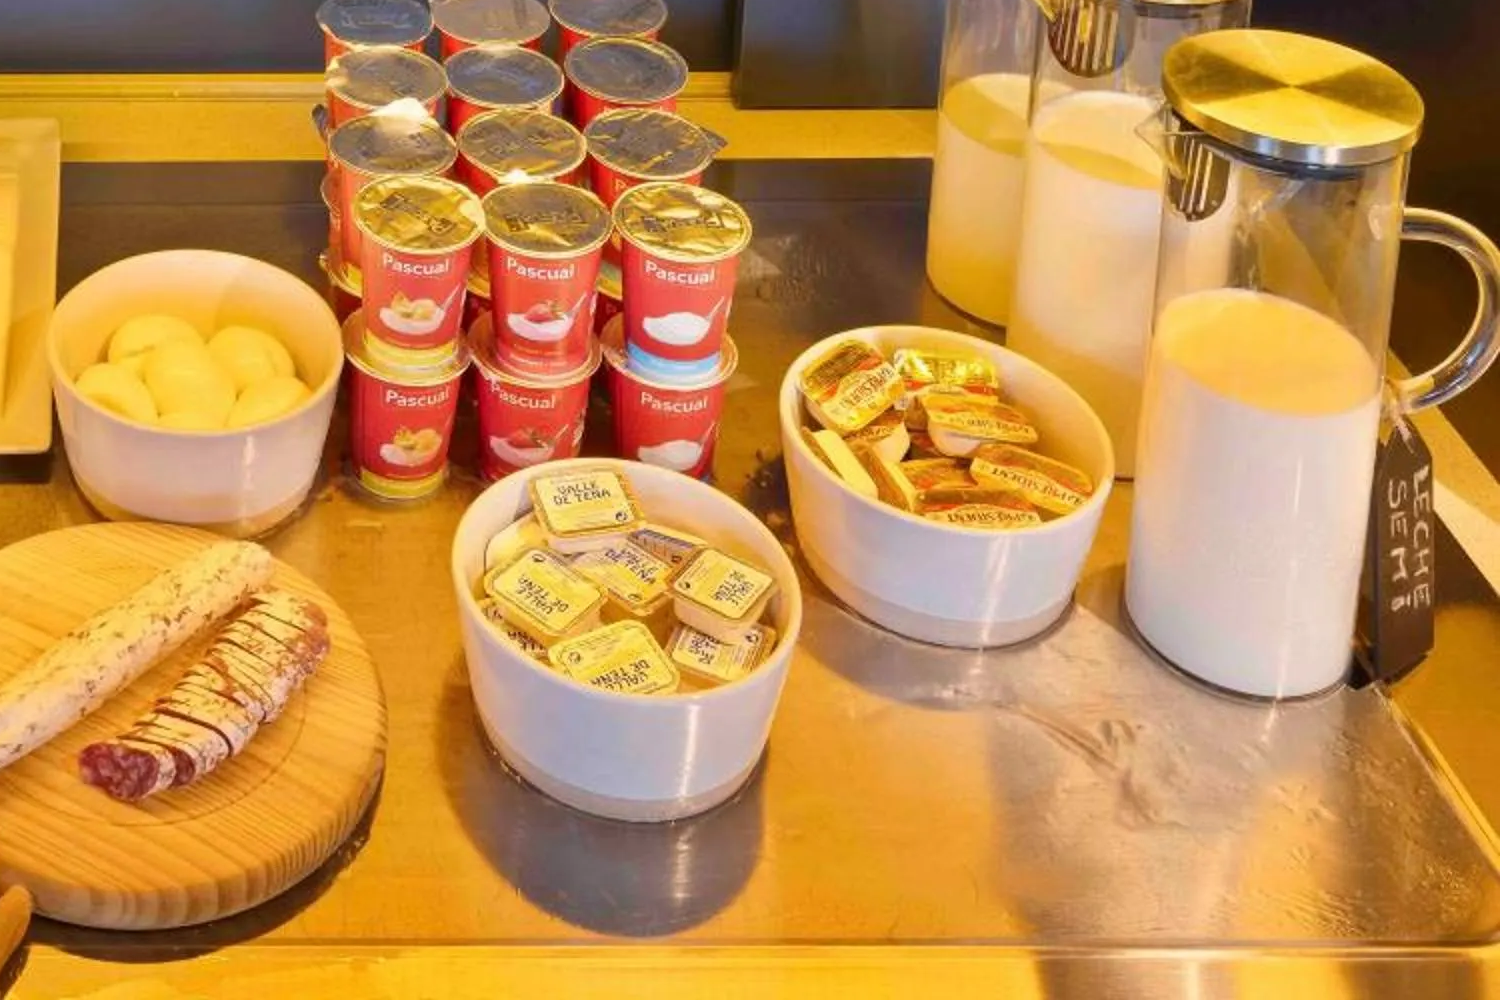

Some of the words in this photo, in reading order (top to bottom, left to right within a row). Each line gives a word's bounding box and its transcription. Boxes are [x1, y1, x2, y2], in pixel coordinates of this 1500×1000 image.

[382, 252, 450, 277] Pascual
[506, 256, 576, 281] Pascual
[644, 259, 716, 286] Pascual
[385, 385, 450, 408] Pascual
[490, 378, 556, 409] Pascual
[641, 391, 709, 413] Pascual
[1412, 464, 1431, 610] LECHE
